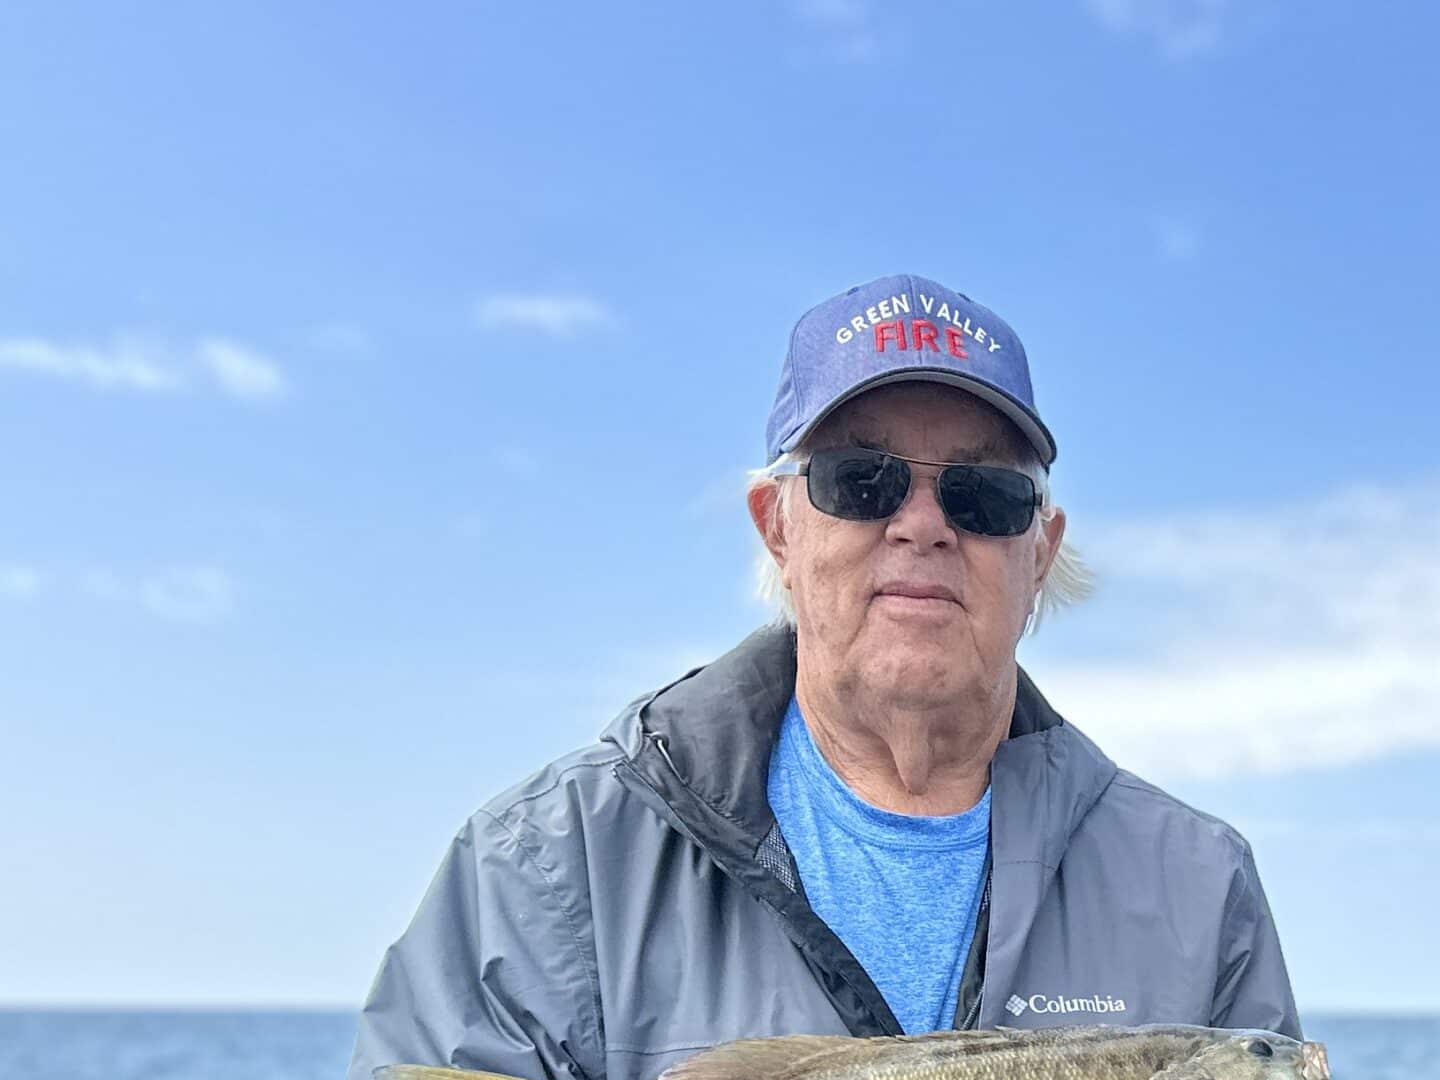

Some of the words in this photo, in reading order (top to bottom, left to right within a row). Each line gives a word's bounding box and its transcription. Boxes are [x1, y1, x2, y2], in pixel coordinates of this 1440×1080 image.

[836, 293, 910, 344] GREEN
[919, 294, 1001, 353] VALLEY
[873, 319, 968, 359] FIRE
[1029, 994, 1126, 1014] Columbia
